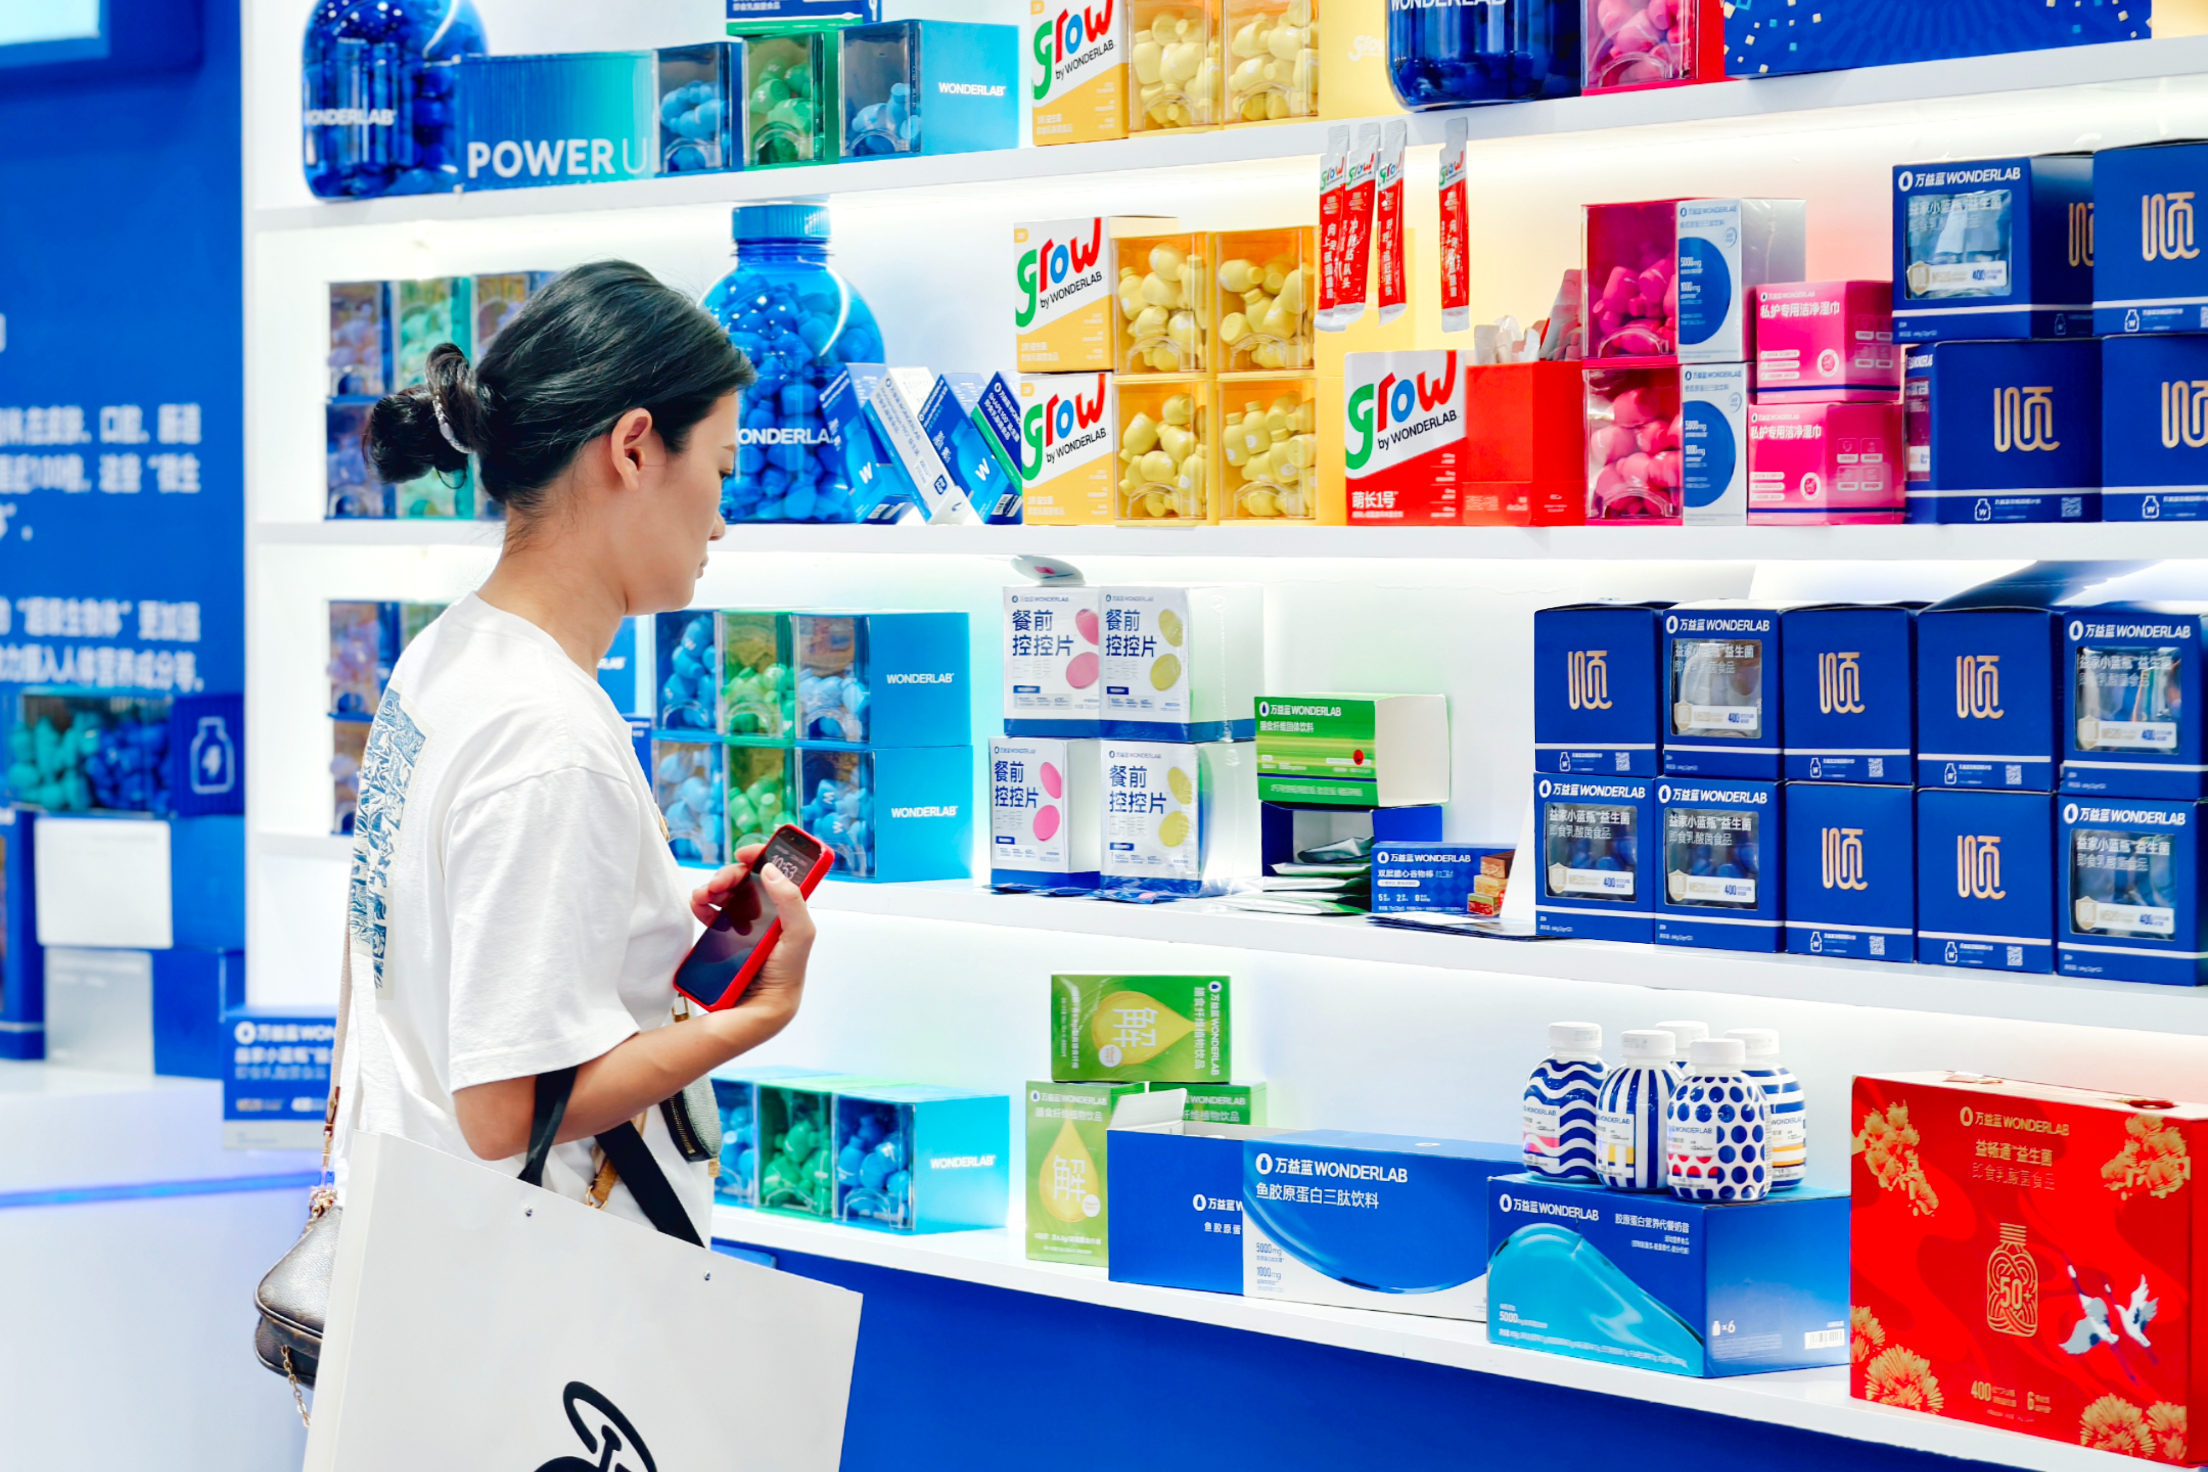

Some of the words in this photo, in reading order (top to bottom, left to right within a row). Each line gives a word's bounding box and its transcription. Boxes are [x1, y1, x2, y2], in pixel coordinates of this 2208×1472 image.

[1033, 0, 1113, 100] grow
[1055, 66, 1064, 80] by
[1064, 39, 1114, 74] WONDERLAB
[938, 81, 1006, 97] WONDERLAB
[467, 139, 615, 178] POWER
[622, 137, 648, 174] U
[1016, 217, 1101, 328] grow
[1040, 297, 1050, 310] by
[1050, 271, 1102, 304] WONDERLAB
[1345, 350, 1457, 470] grow
[736, 427, 833, 445] ONDERLA
[1021, 373, 1106, 481] grow
[1378, 437, 1390, 450] by
[1390, 409, 1458, 444] WONDERLAB
[1046, 451, 1056, 464] by
[1056, 427, 1107, 457] WONDERLAB
[1012, 609, 1053, 632] 餐前
[1106, 609, 1141, 632] 餐前
[1012, 634, 1074, 657] 控控片
[1106, 634, 1157, 657] 控控片
[887, 672, 954, 685] WONDERLAB
[994, 760, 1024, 783] 餐前
[1109, 765, 1147, 788] 餐前
[995, 786, 1039, 809] 控控片
[1109, 791, 1167, 814] 控控片
[891, 805, 958, 819] WONDERLAB
[1112, 1006, 1159, 1048] 解
[1185, 1095, 1246, 1105] WONDERLAB
[930, 1155, 996, 1169] WONDERLAB
[1052, 1155, 1086, 1201] 解
